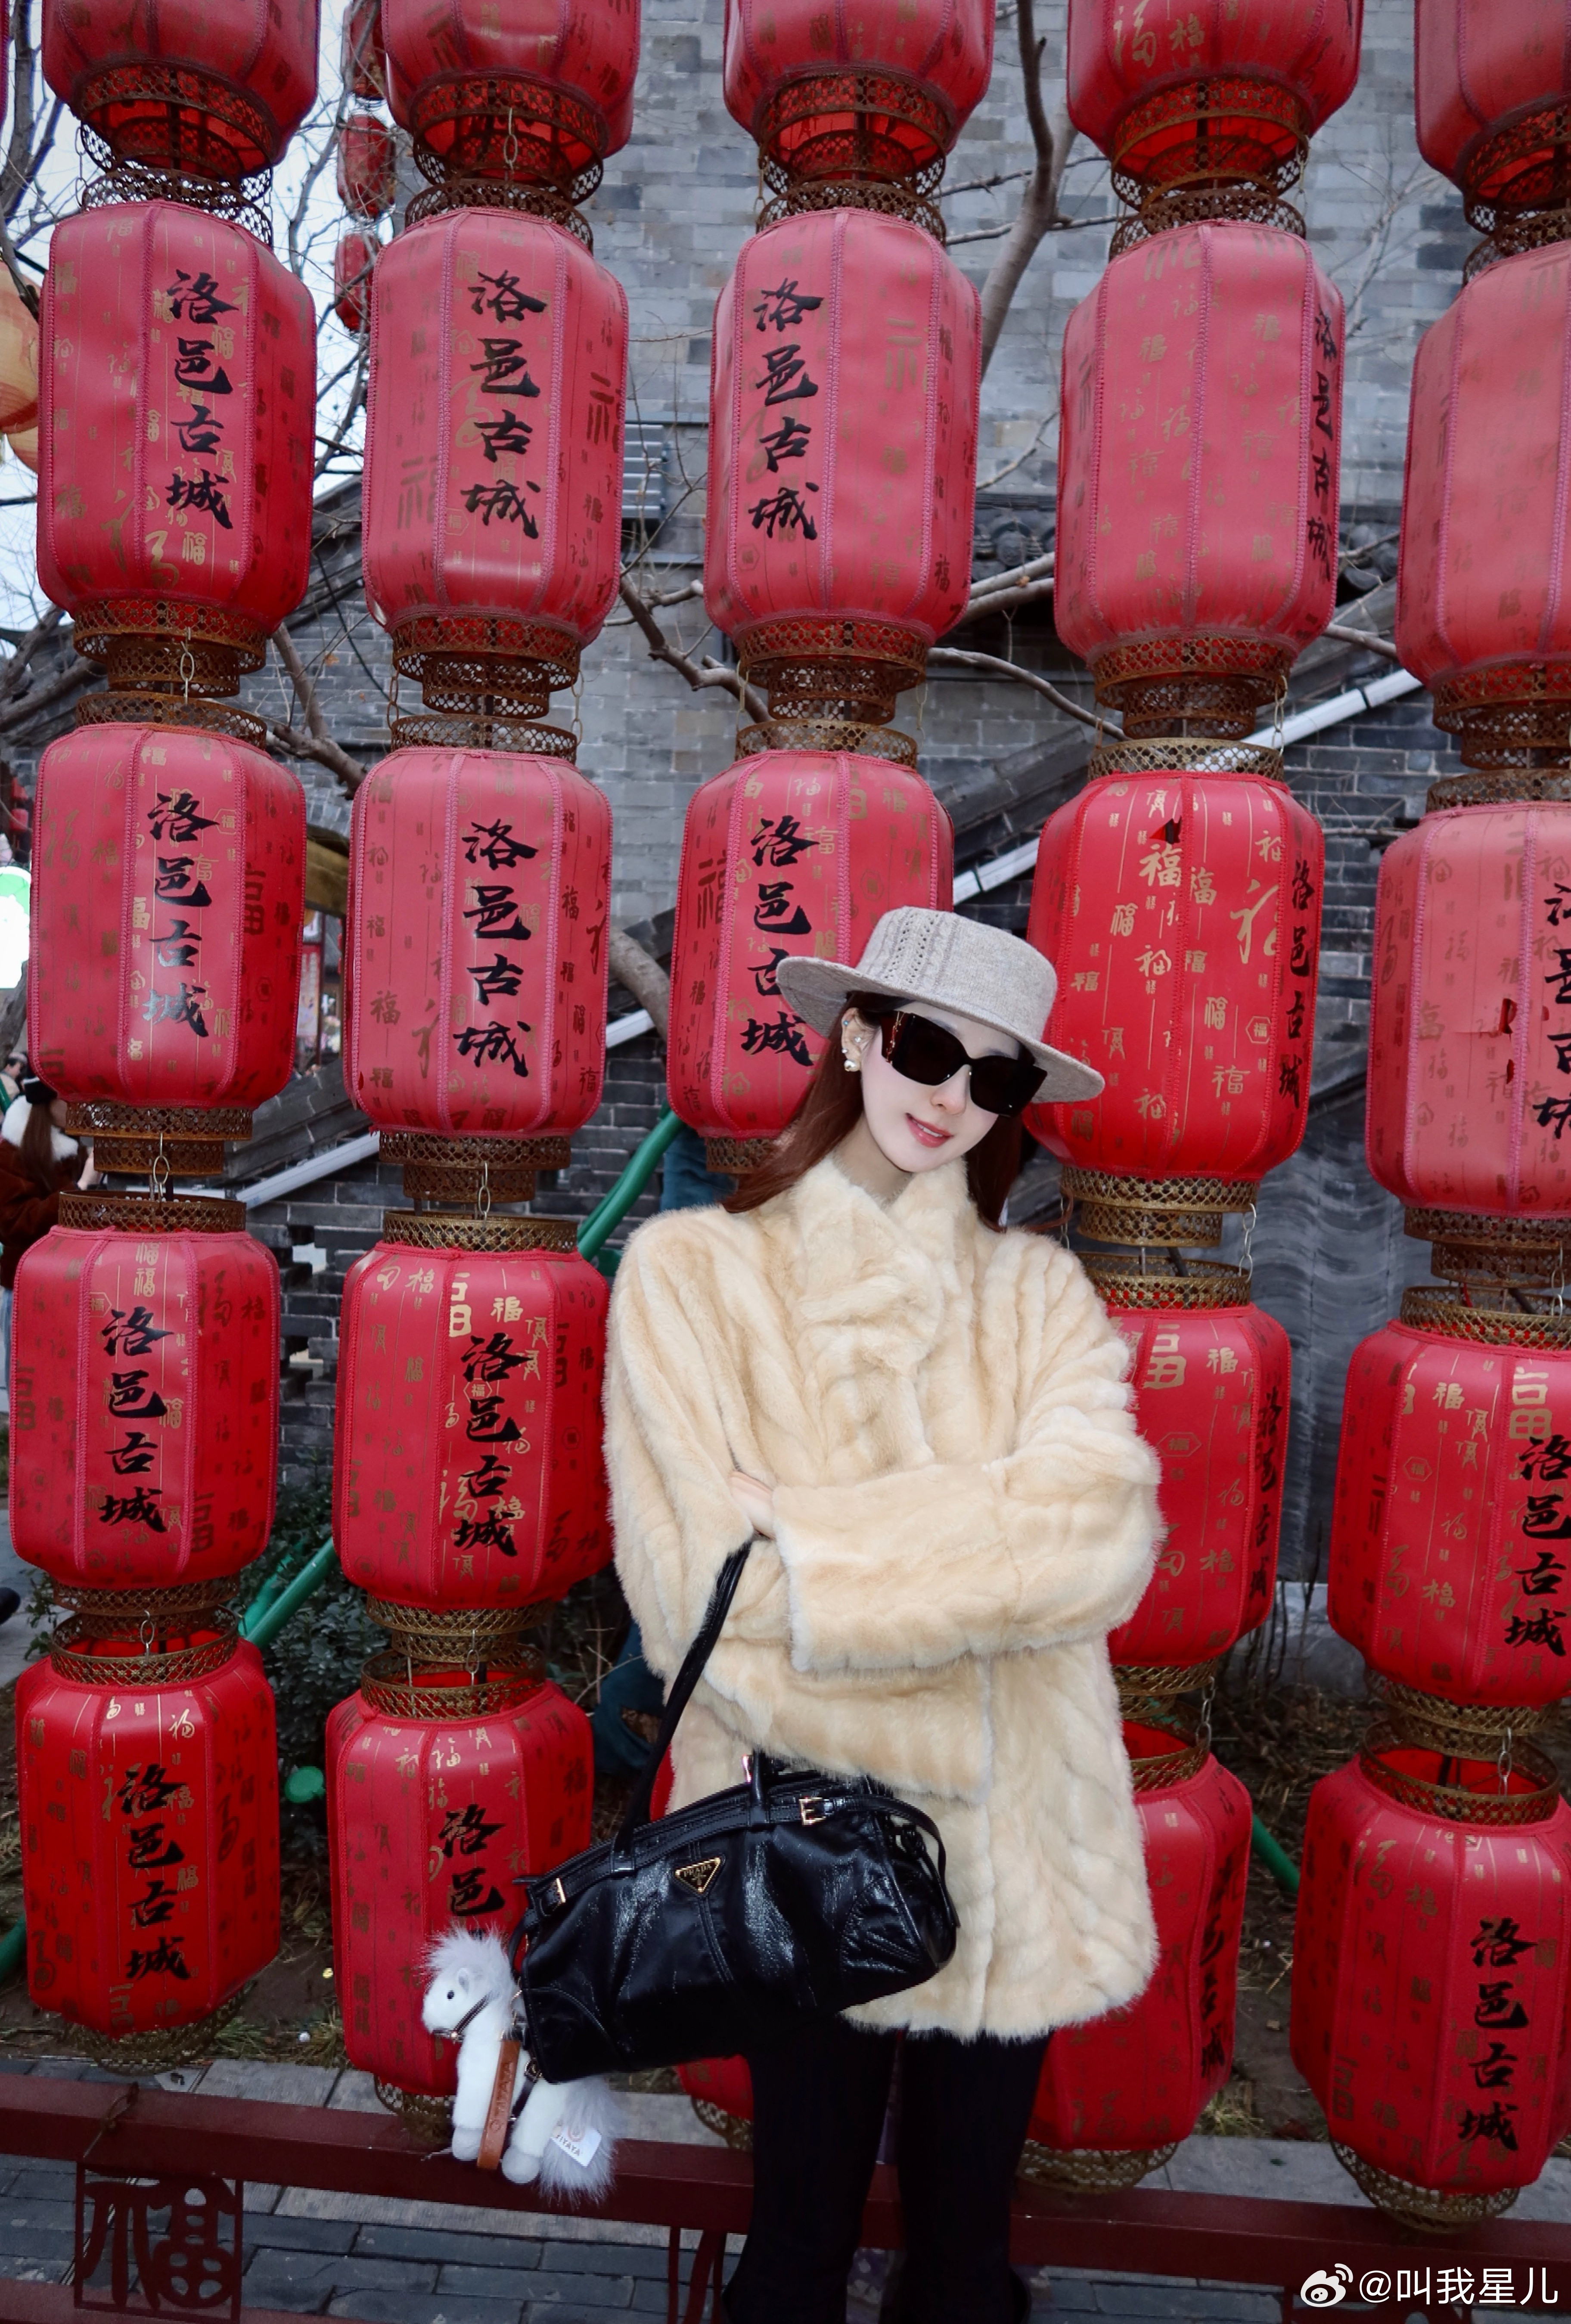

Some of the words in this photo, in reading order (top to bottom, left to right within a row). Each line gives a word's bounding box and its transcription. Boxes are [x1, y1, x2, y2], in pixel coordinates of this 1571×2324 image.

[166, 269, 239, 530] 洛邑古城
[461, 270, 547, 540] 洛邑古城
[748, 278, 824, 540] 洛邑古城
[142, 792, 220, 1038] 洛邑古城
[453, 819, 538, 1078] 洛邑古城
[740, 815, 820, 1067] 洛邑古城
[1140, 844, 1183, 887] 福
[1279, 860, 1315, 1109] 洛邑古城
[98, 1306, 174, 1533] 洛邑古城
[453, 1332, 533, 1557] 洛邑古城
[1504, 1434, 1571, 1657] 洛邑古城
[117, 1764, 189, 1981] 洛邑古城
[438, 1803, 506, 1939] 洛邑
[1458, 1916, 1538, 2152] 洛邑古城
